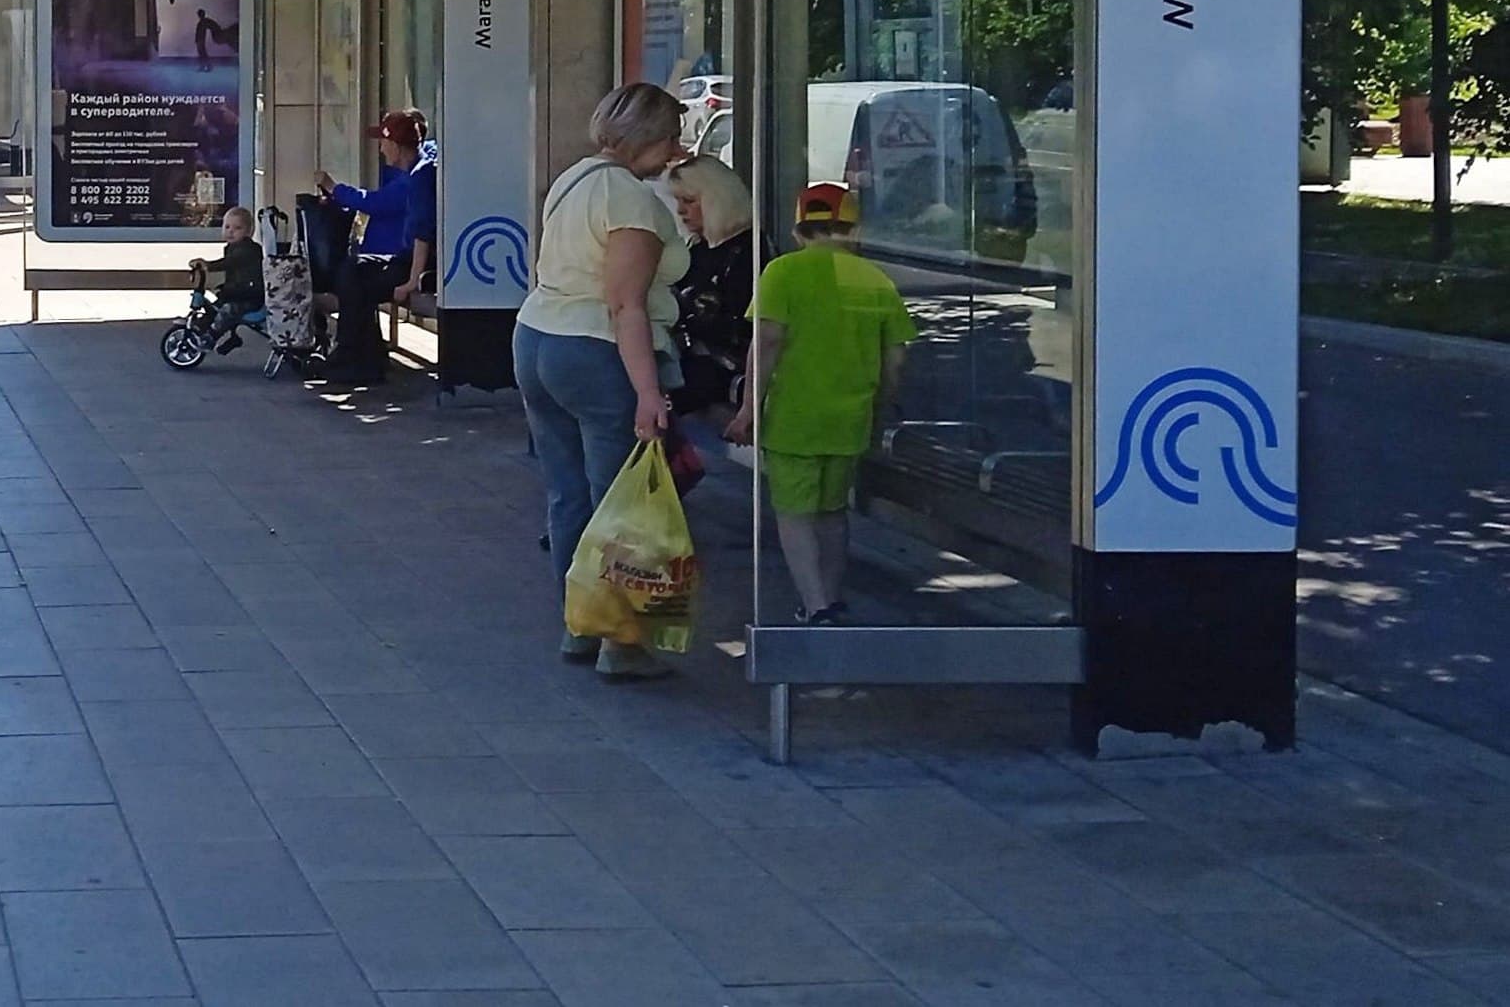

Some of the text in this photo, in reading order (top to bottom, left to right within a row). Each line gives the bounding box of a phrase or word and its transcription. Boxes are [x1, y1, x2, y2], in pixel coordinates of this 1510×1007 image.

[70, 94, 226, 106] Каждый район нуждается
[70, 107, 175, 118] в суперводителе.
[70, 186, 150, 194] 8 800 220 2202
[70, 196, 150, 204] 8 495 622 2222
